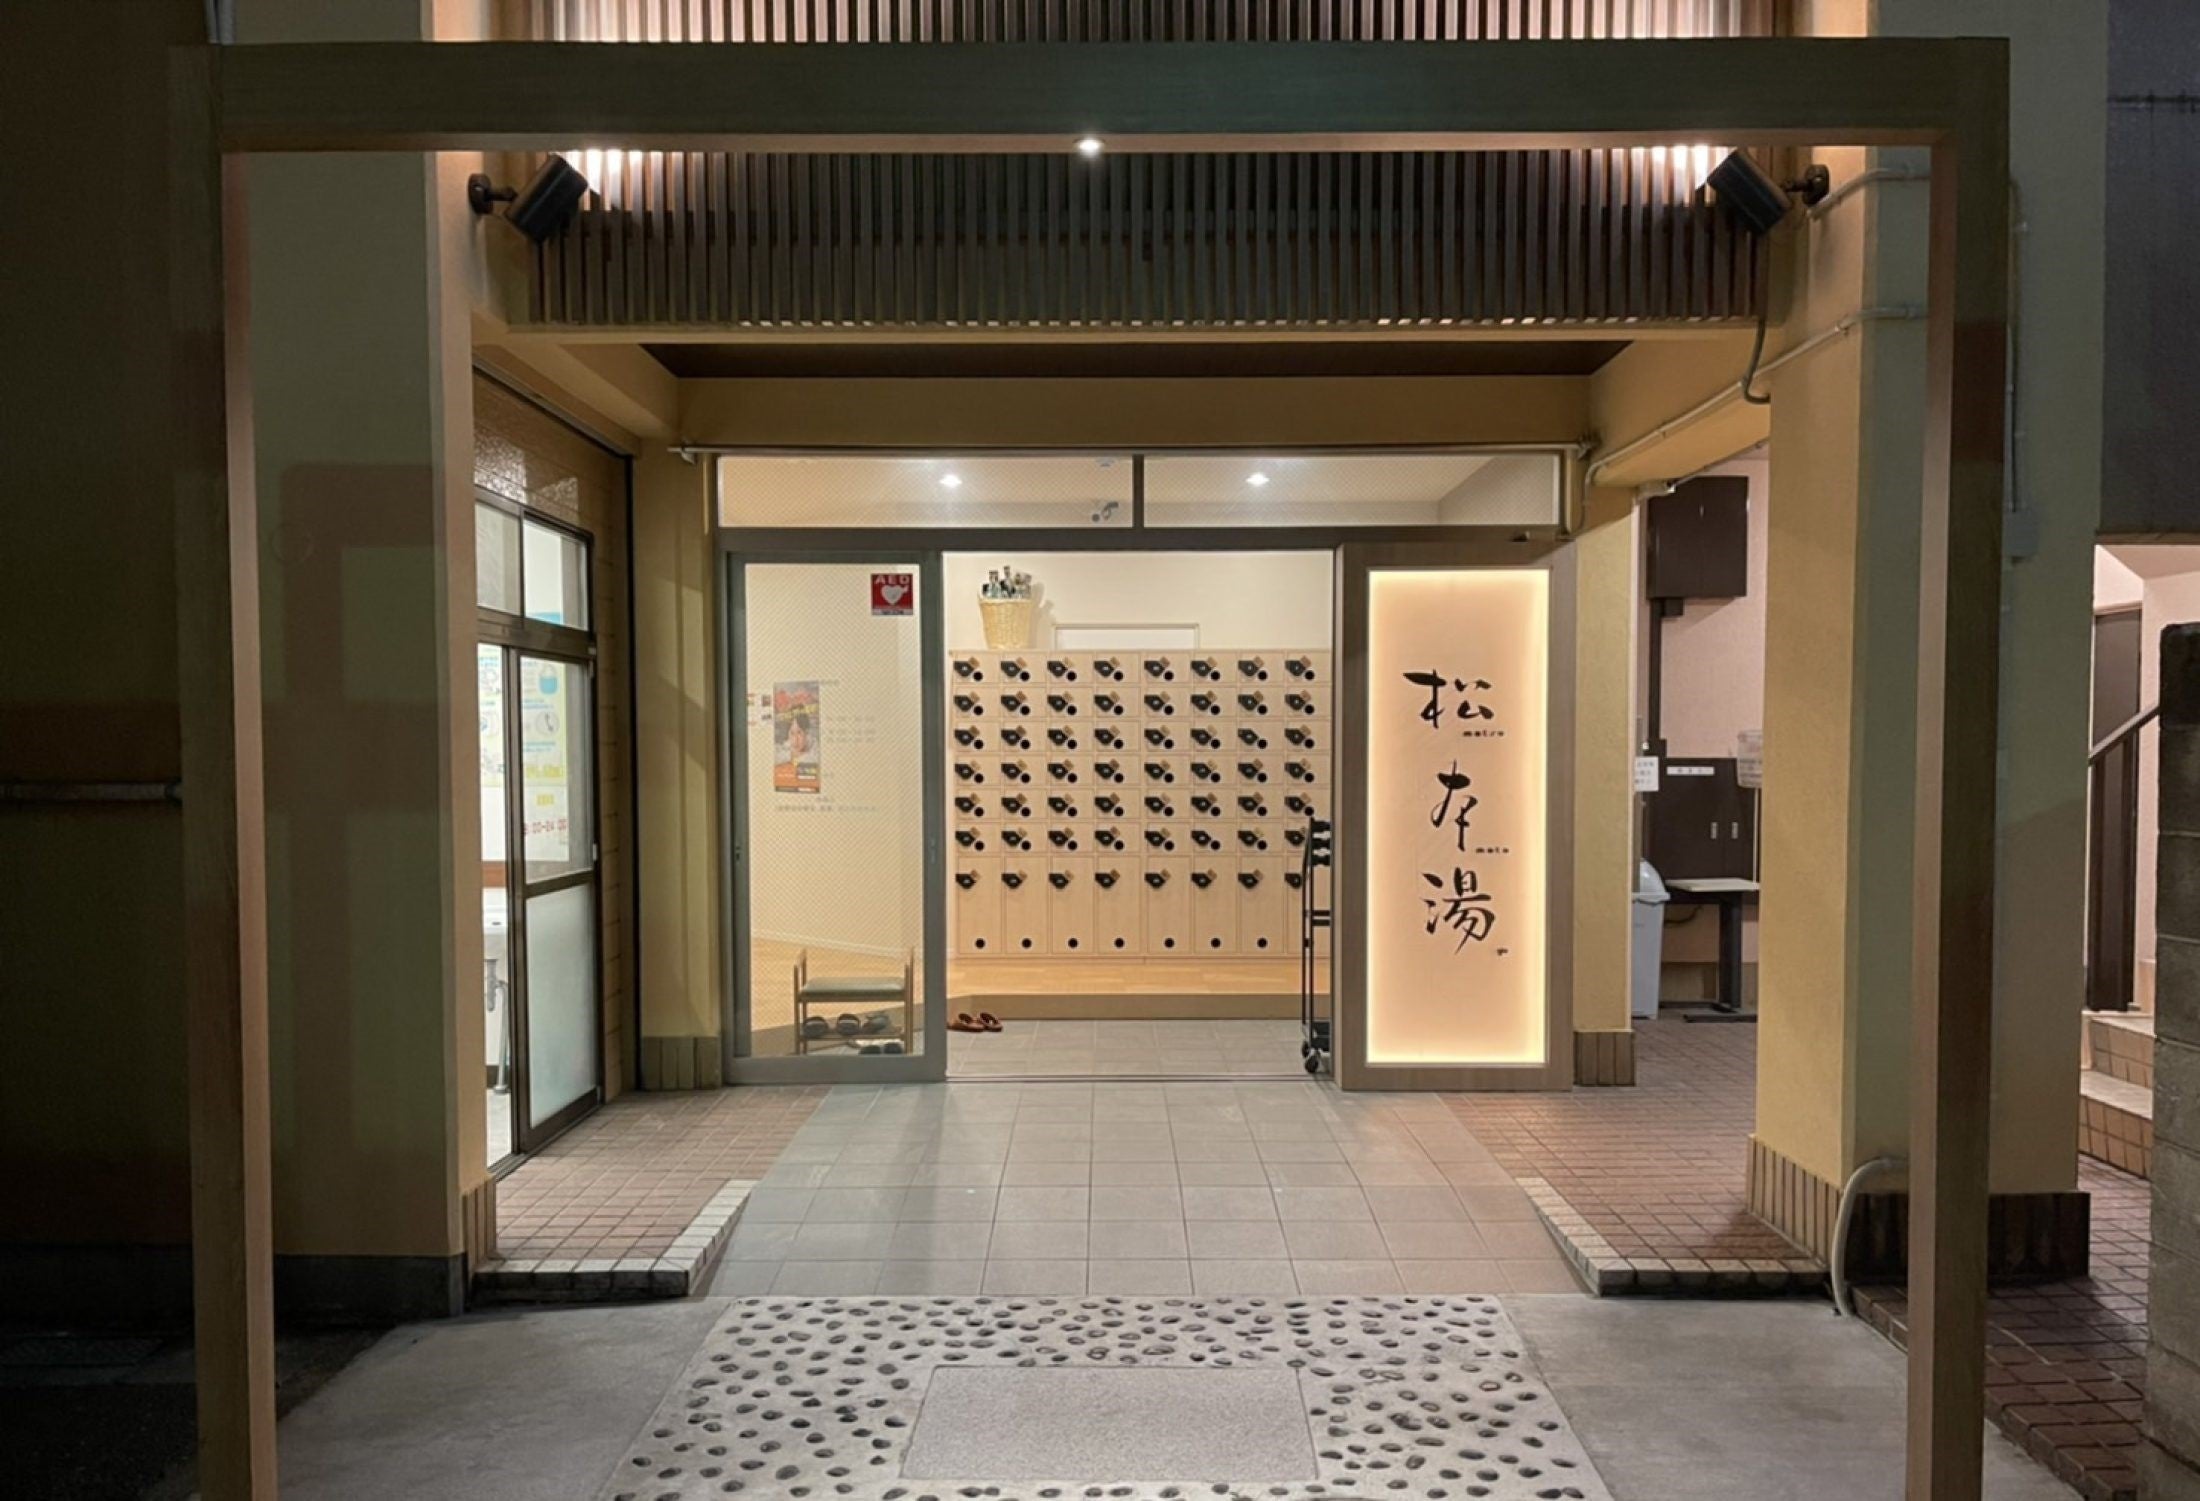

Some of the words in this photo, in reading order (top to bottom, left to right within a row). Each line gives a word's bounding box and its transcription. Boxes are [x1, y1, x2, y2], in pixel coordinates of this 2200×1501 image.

[874, 573, 911, 585] AED
[1403, 668, 1495, 955] 松本湯
